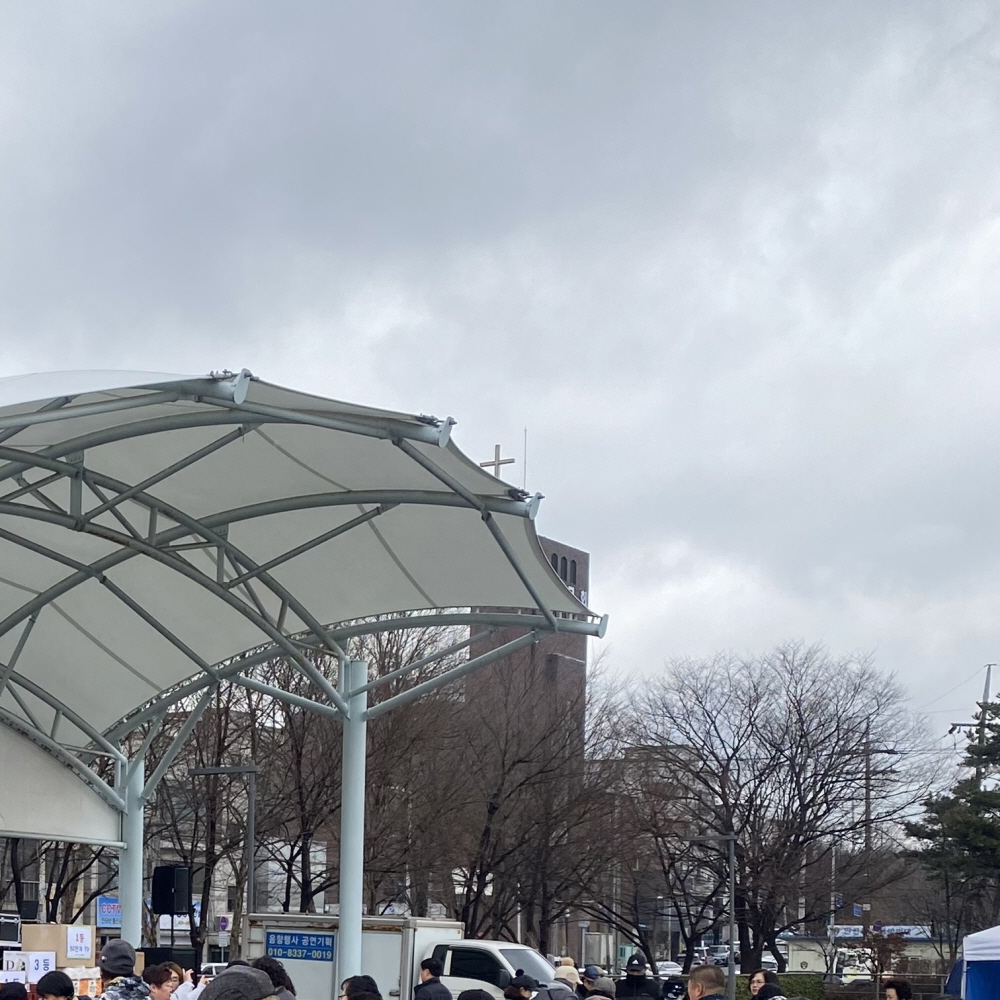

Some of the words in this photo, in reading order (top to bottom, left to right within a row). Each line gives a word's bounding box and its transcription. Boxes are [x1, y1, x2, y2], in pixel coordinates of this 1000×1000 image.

[268, 934, 299, 946] 음향행사
[301, 935, 332, 947] 공연기획
[267, 947, 332, 960] 010-8337-0019
